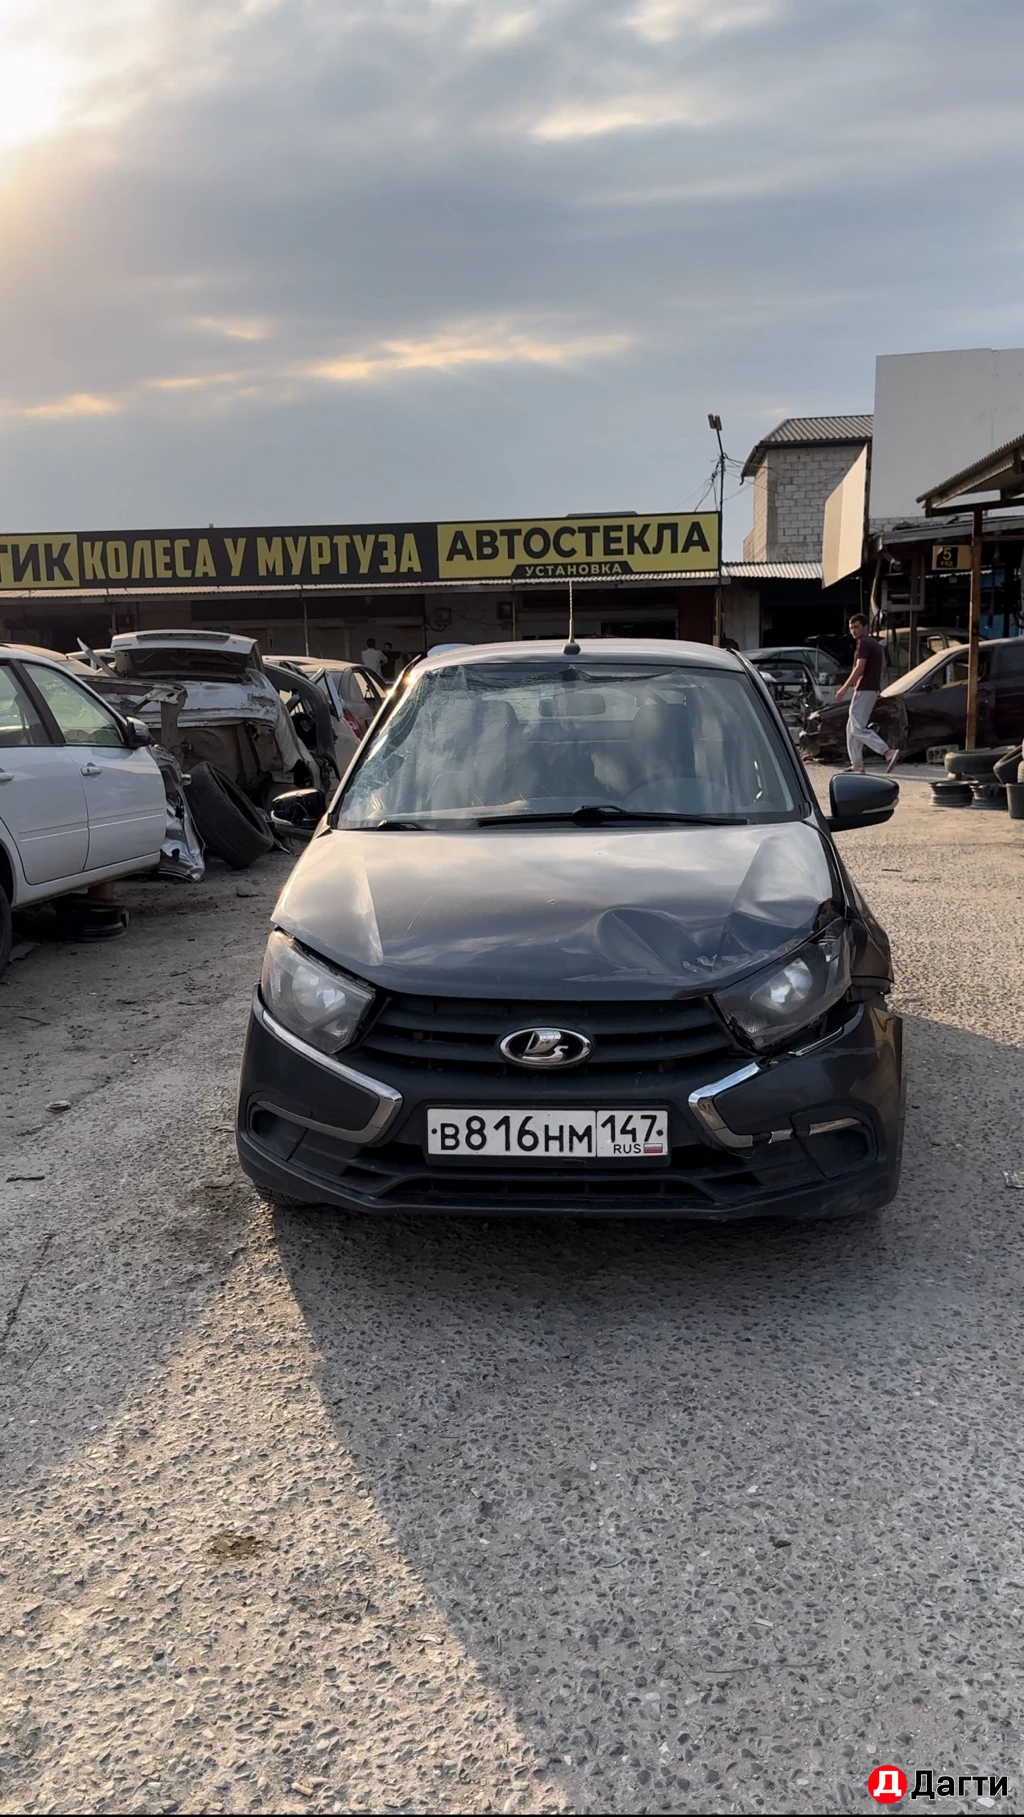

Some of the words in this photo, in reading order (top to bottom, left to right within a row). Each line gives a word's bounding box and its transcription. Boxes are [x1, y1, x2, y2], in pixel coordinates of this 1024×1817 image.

[446, 521, 711, 561] АВТОСТЕКЛА
[943, 547, 951, 560] 5
[82, 538, 217, 580] КОЛЕСА
[223, 537, 247, 577] У
[256, 533, 422, 577] МУРТУЗА
[525, 563, 623, 577] УСТАНОВКА
[440, 1115, 593, 1153] В816НМ
[601, 1115, 658, 1143] 147
[613, 1143, 642, 1154] RUS
